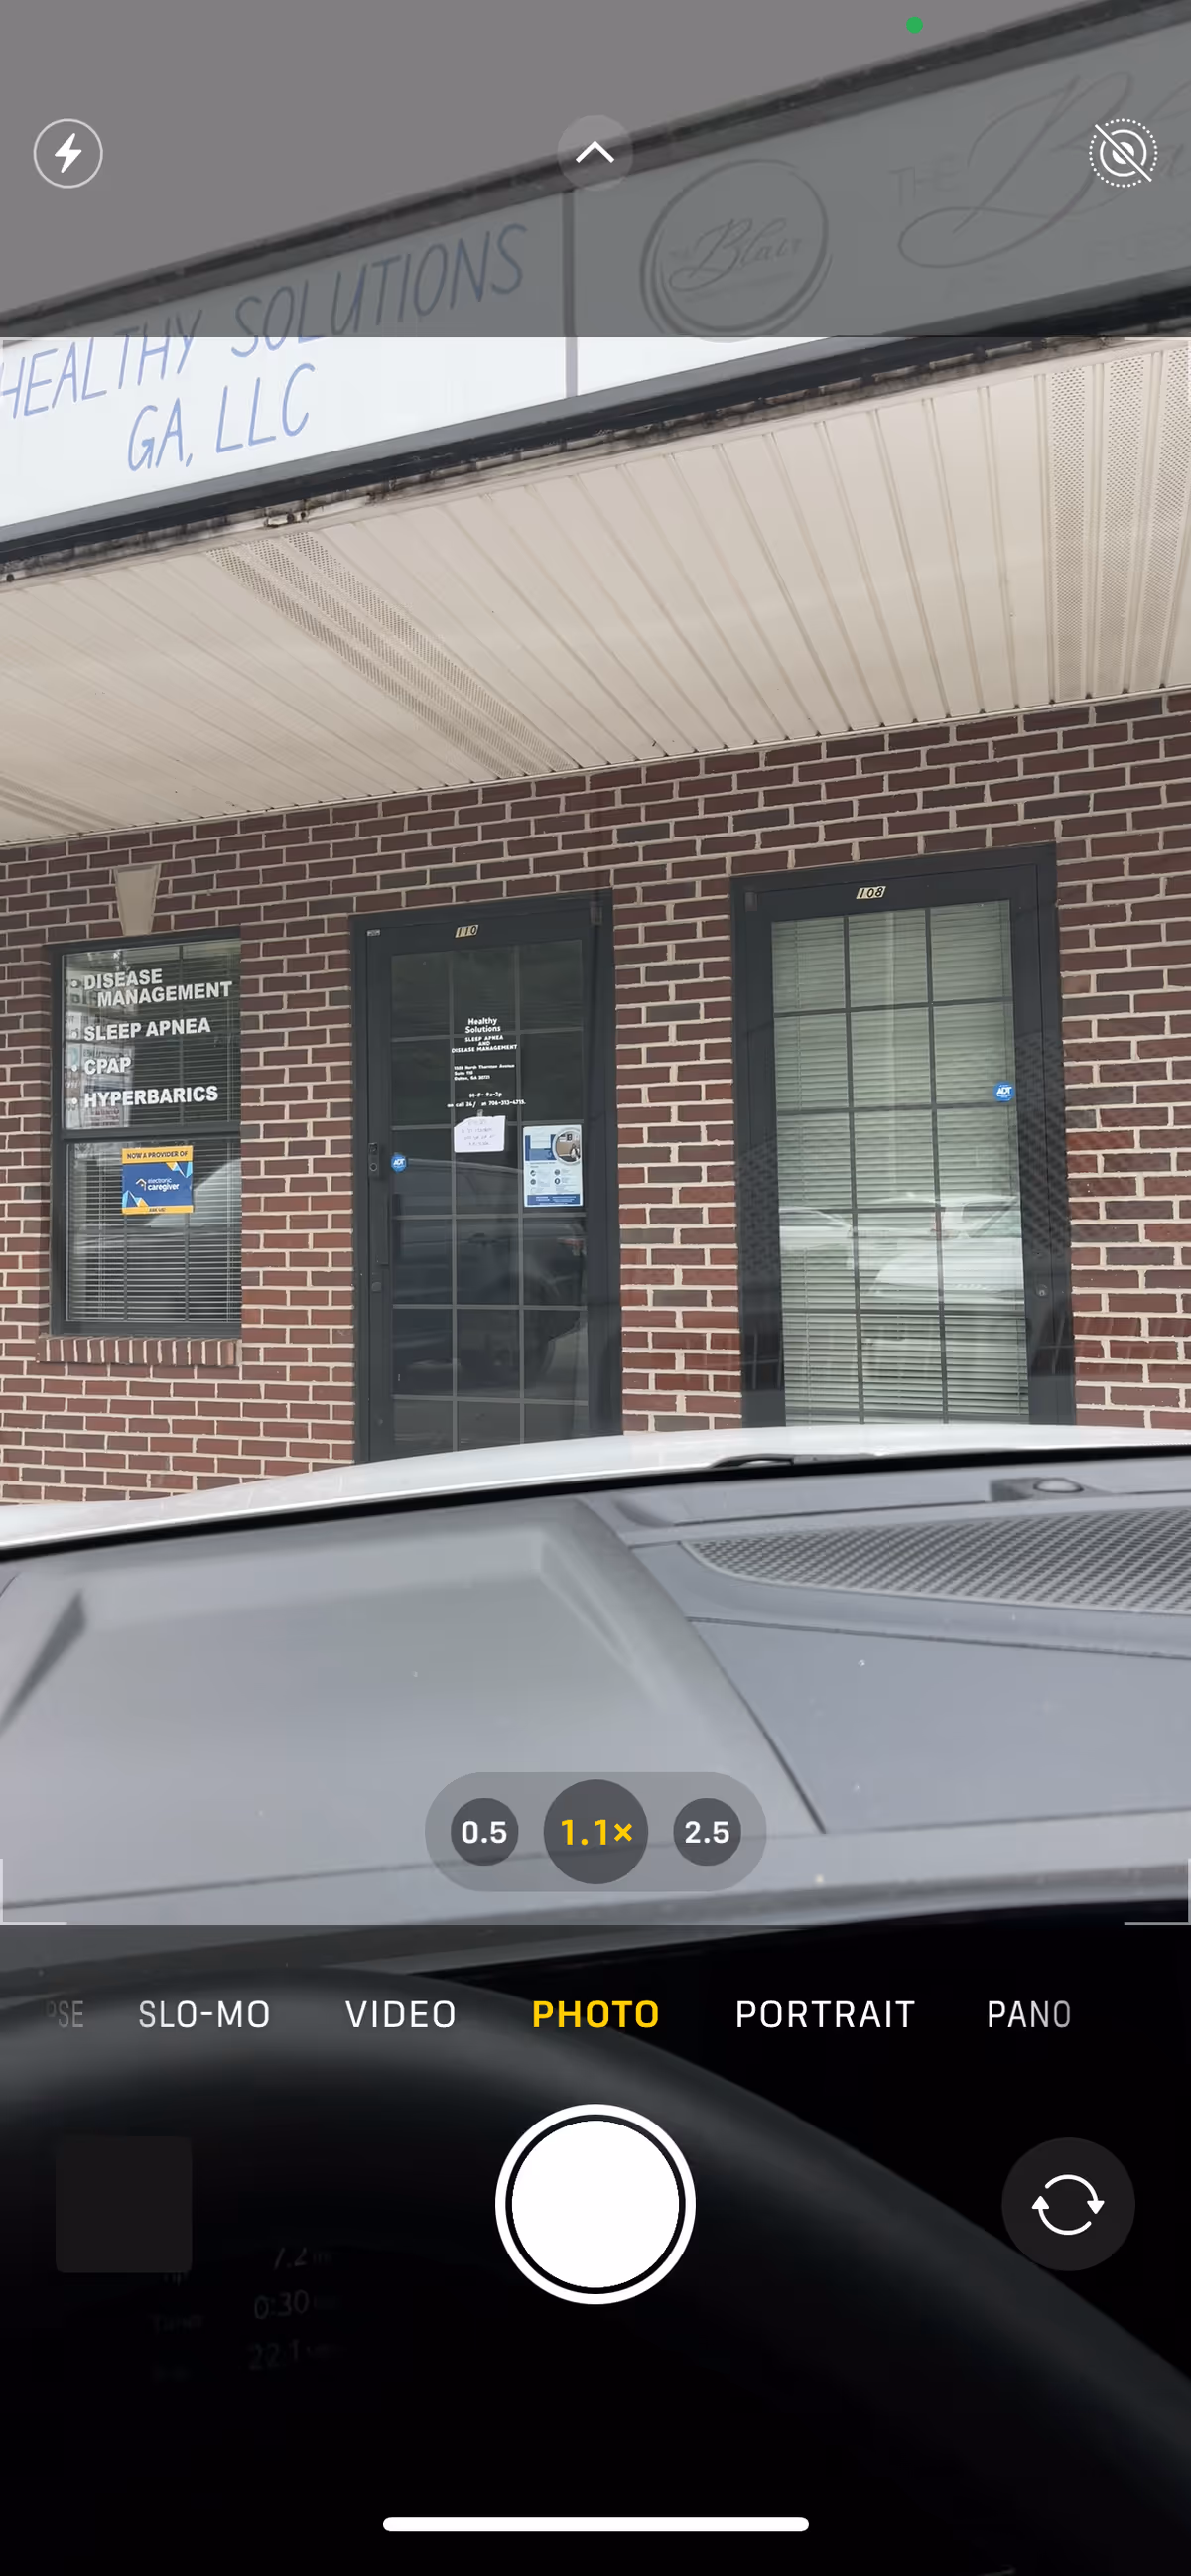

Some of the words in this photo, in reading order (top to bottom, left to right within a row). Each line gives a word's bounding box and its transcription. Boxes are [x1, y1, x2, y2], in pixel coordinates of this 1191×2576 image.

[0, 309, 202, 419] HEALTHY
[231, 223, 528, 358] SOLUTIONS
[128, 397, 193, 472] GA,
[215, 362, 316, 454] LLC
[860, 886, 883, 898] 108
[457, 925, 478, 937] 110
[83, 967, 163, 990] DISEASE
[97, 981, 233, 1008] MANAGEMENT
[83, 1022, 142, 1042] SLEEP
[146, 1017, 211, 1037] APNEA
[464, 1025, 501, 1034] Solutions
[467, 1016, 498, 1026] Healthy
[83, 1057, 132, 1075] CPAP
[83, 1086, 218, 1108] HYPERBARICS
[996, 1086, 1012, 1095] ADT
[147, 1183, 180, 1192] caregiver
